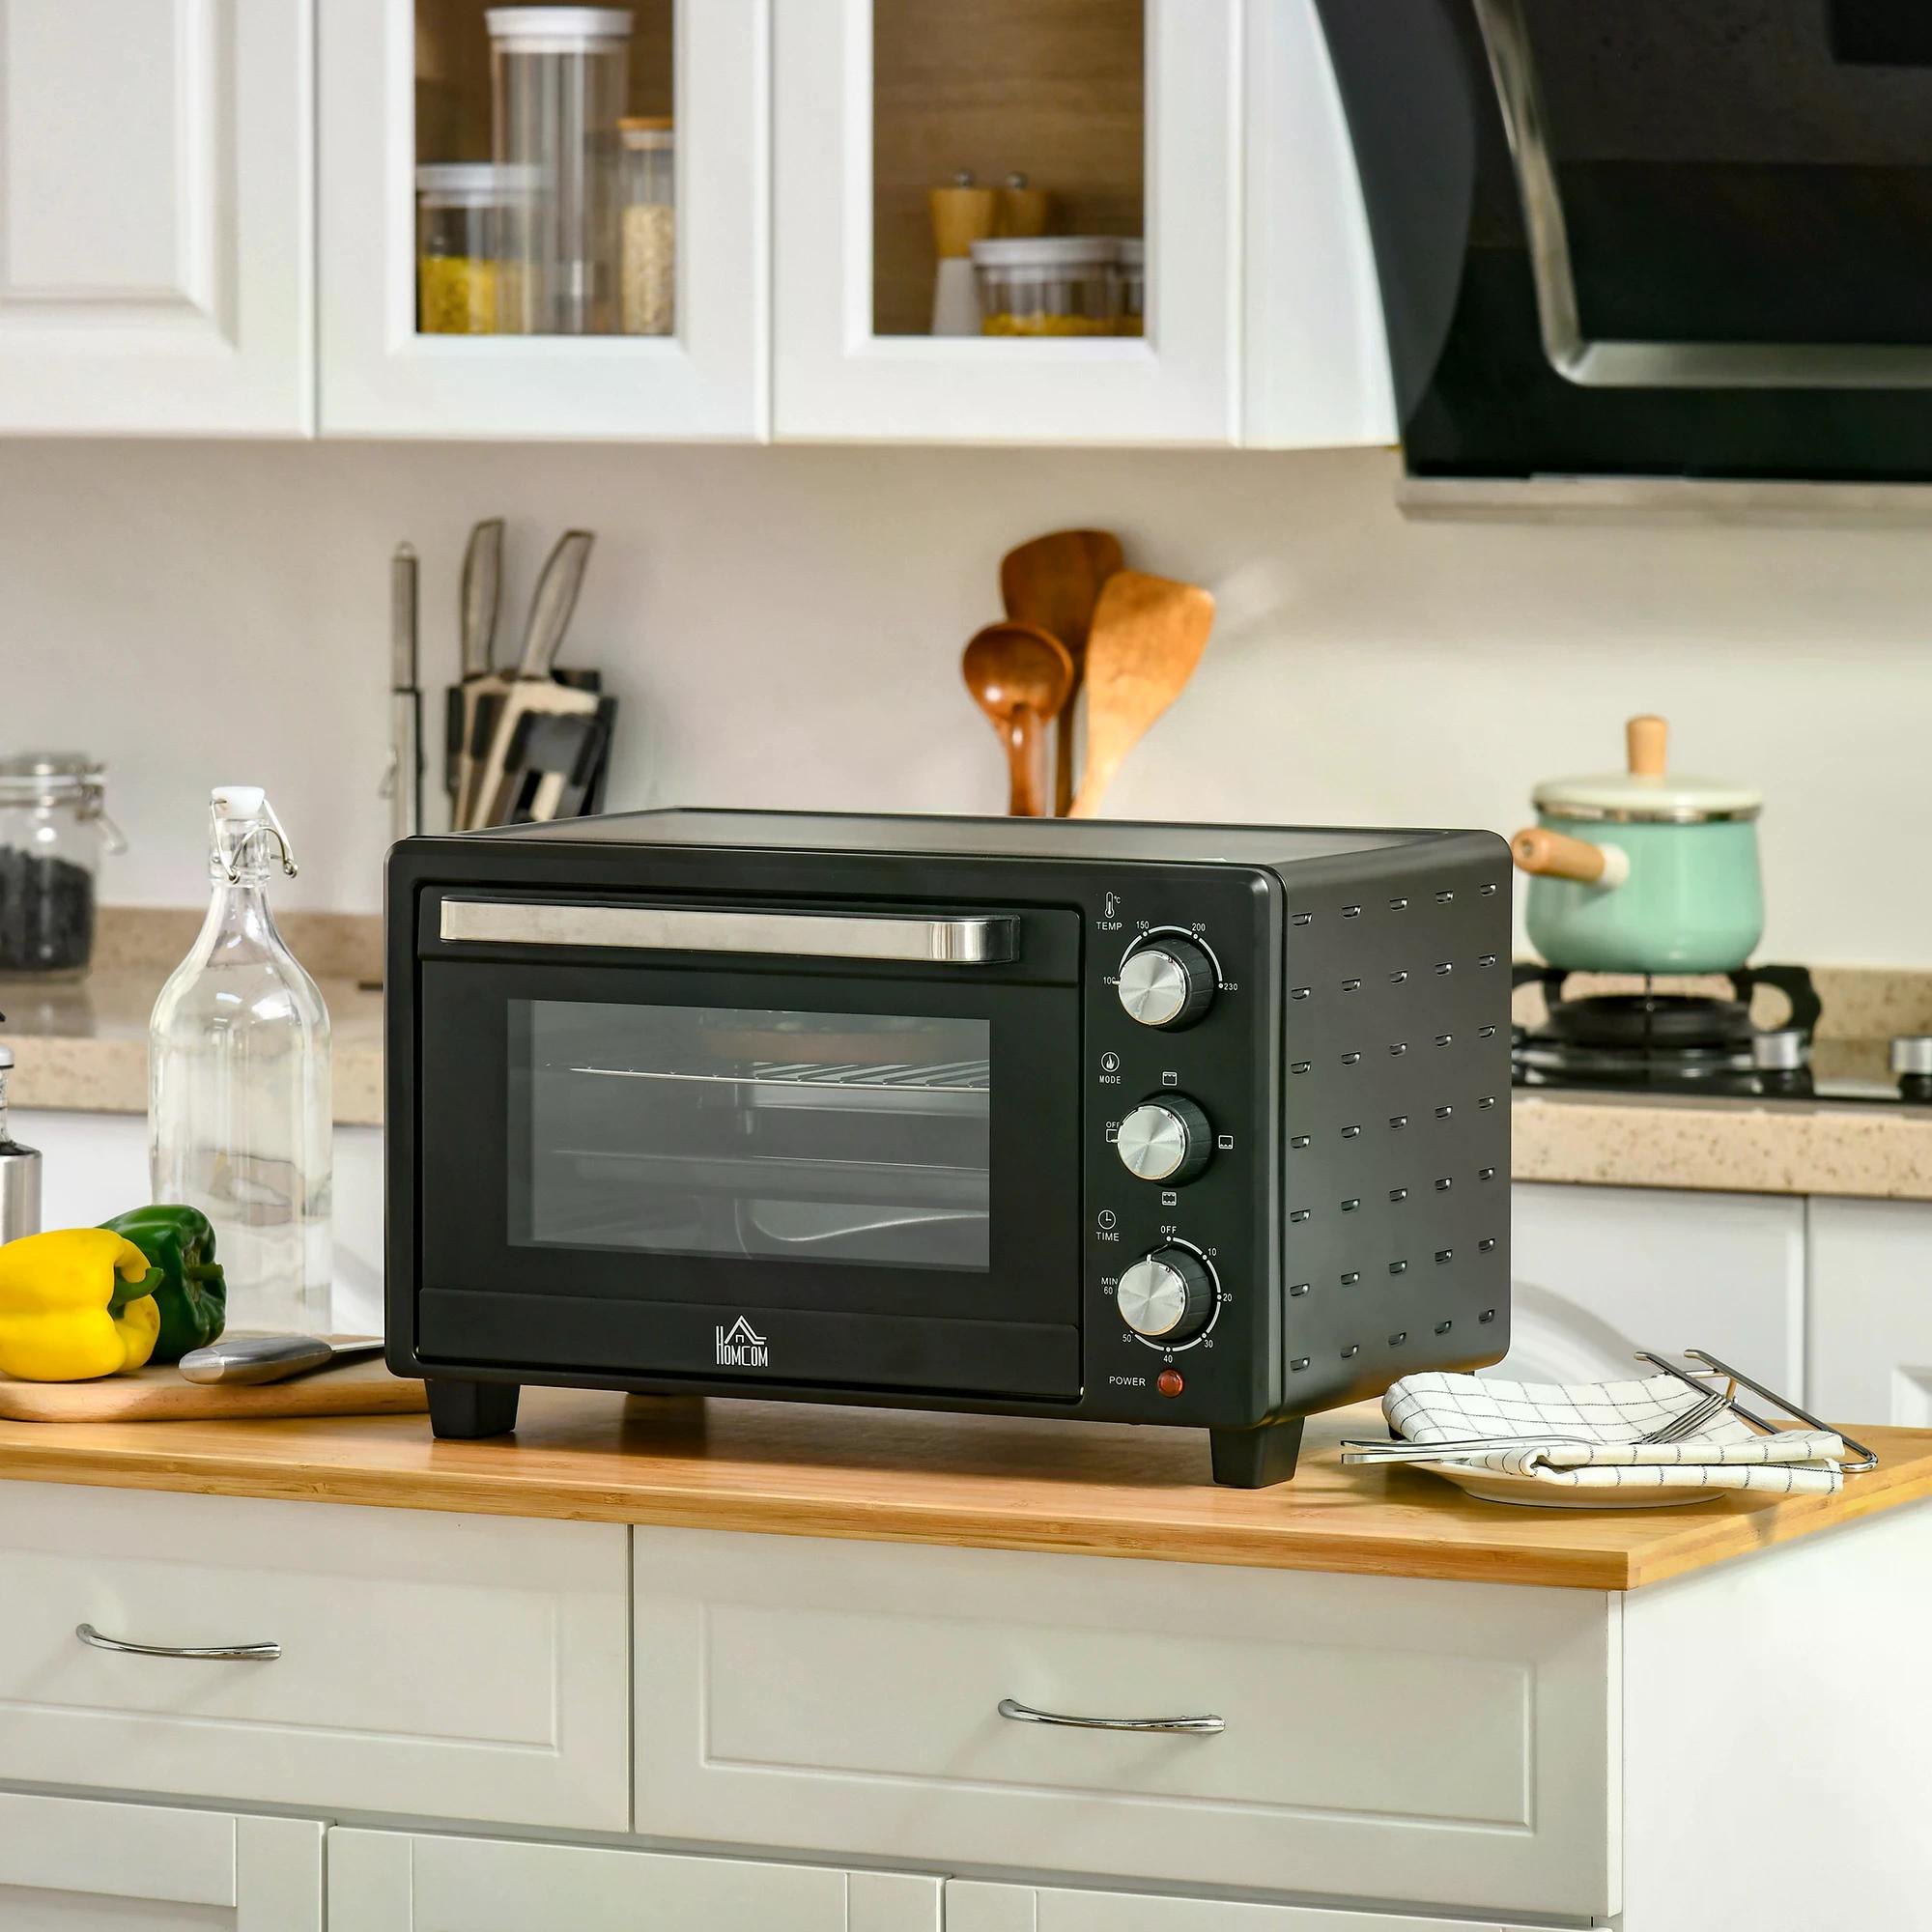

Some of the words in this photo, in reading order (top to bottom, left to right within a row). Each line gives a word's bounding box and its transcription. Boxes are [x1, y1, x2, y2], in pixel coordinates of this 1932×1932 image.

[1095, 921, 1123, 931] TEMP
[1135, 920, 1150, 929] 150
[1190, 922, 1207, 932] 200
[1223, 982, 1238, 991] 230
[1098, 1074, 1122, 1085] MODE
[1160, 1225, 1178, 1235] OFF
[1095, 1231, 1120, 1242] TIME
[1208, 1247, 1217, 1257] 10
[1100, 1276, 1119, 1286] MIN
[1103, 1286, 1114, 1295] 60
[1222, 1293, 1233, 1302] 20
[1122, 1333, 1132, 1343] 50
[716, 1325, 768, 1367] HOMCOM
[1204, 1339, 1214, 1349] 30
[1163, 1354, 1174, 1364] 40
[1109, 1376, 1146, 1387] POWER
